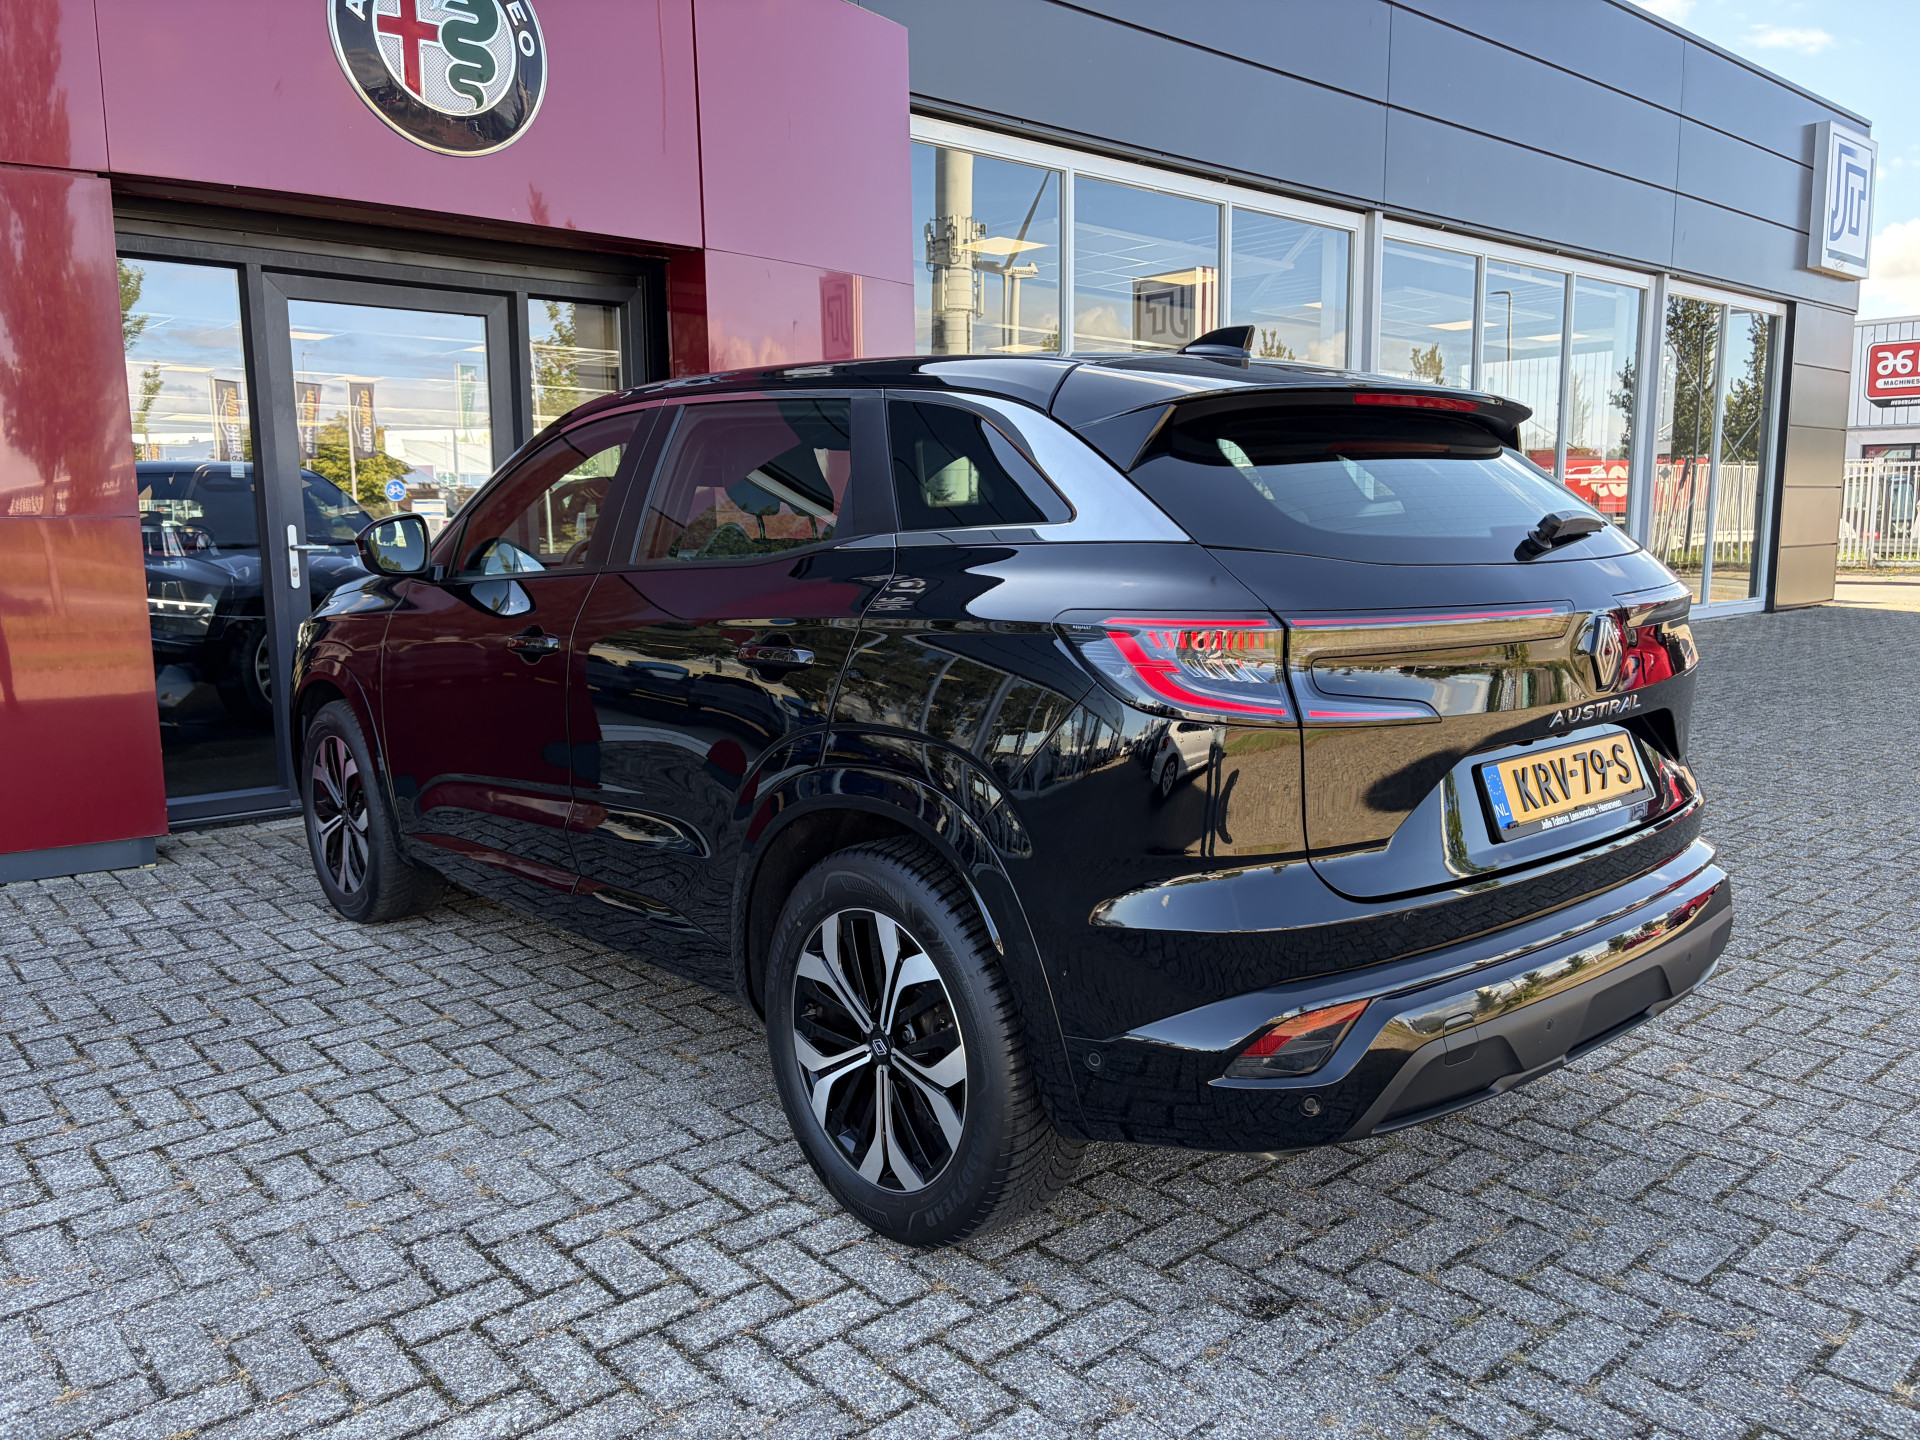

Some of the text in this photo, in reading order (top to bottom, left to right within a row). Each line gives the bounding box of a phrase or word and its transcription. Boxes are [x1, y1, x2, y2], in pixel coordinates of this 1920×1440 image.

[1883, 378, 1920, 387] MACHINES
[1549, 694, 1641, 728] AUSTRAL
[1512, 743, 1632, 812] KRV-79-S
[1494, 803, 1510, 817] NL
